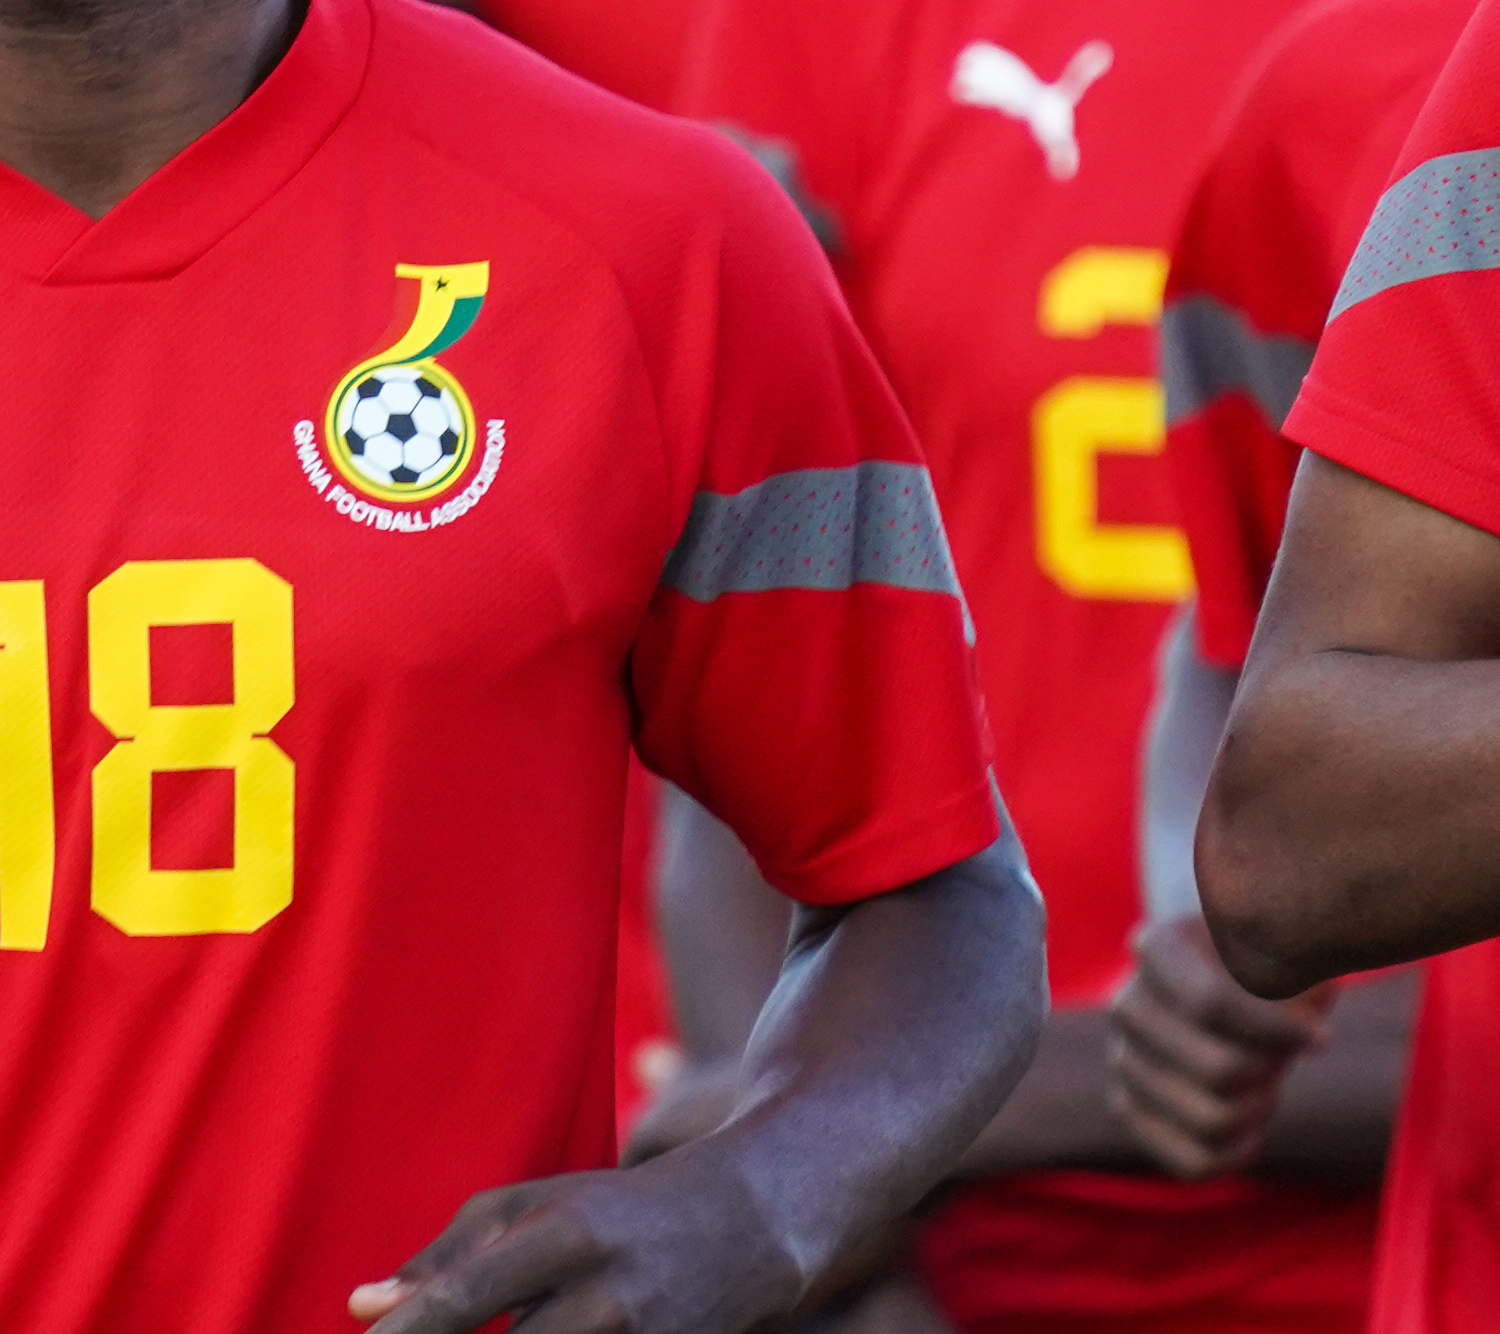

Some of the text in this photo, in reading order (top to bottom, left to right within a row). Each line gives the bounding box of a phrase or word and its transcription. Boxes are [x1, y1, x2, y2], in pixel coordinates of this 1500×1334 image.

[293, 419, 506, 533] GHANA FOOTBALL ASSOCIATION
